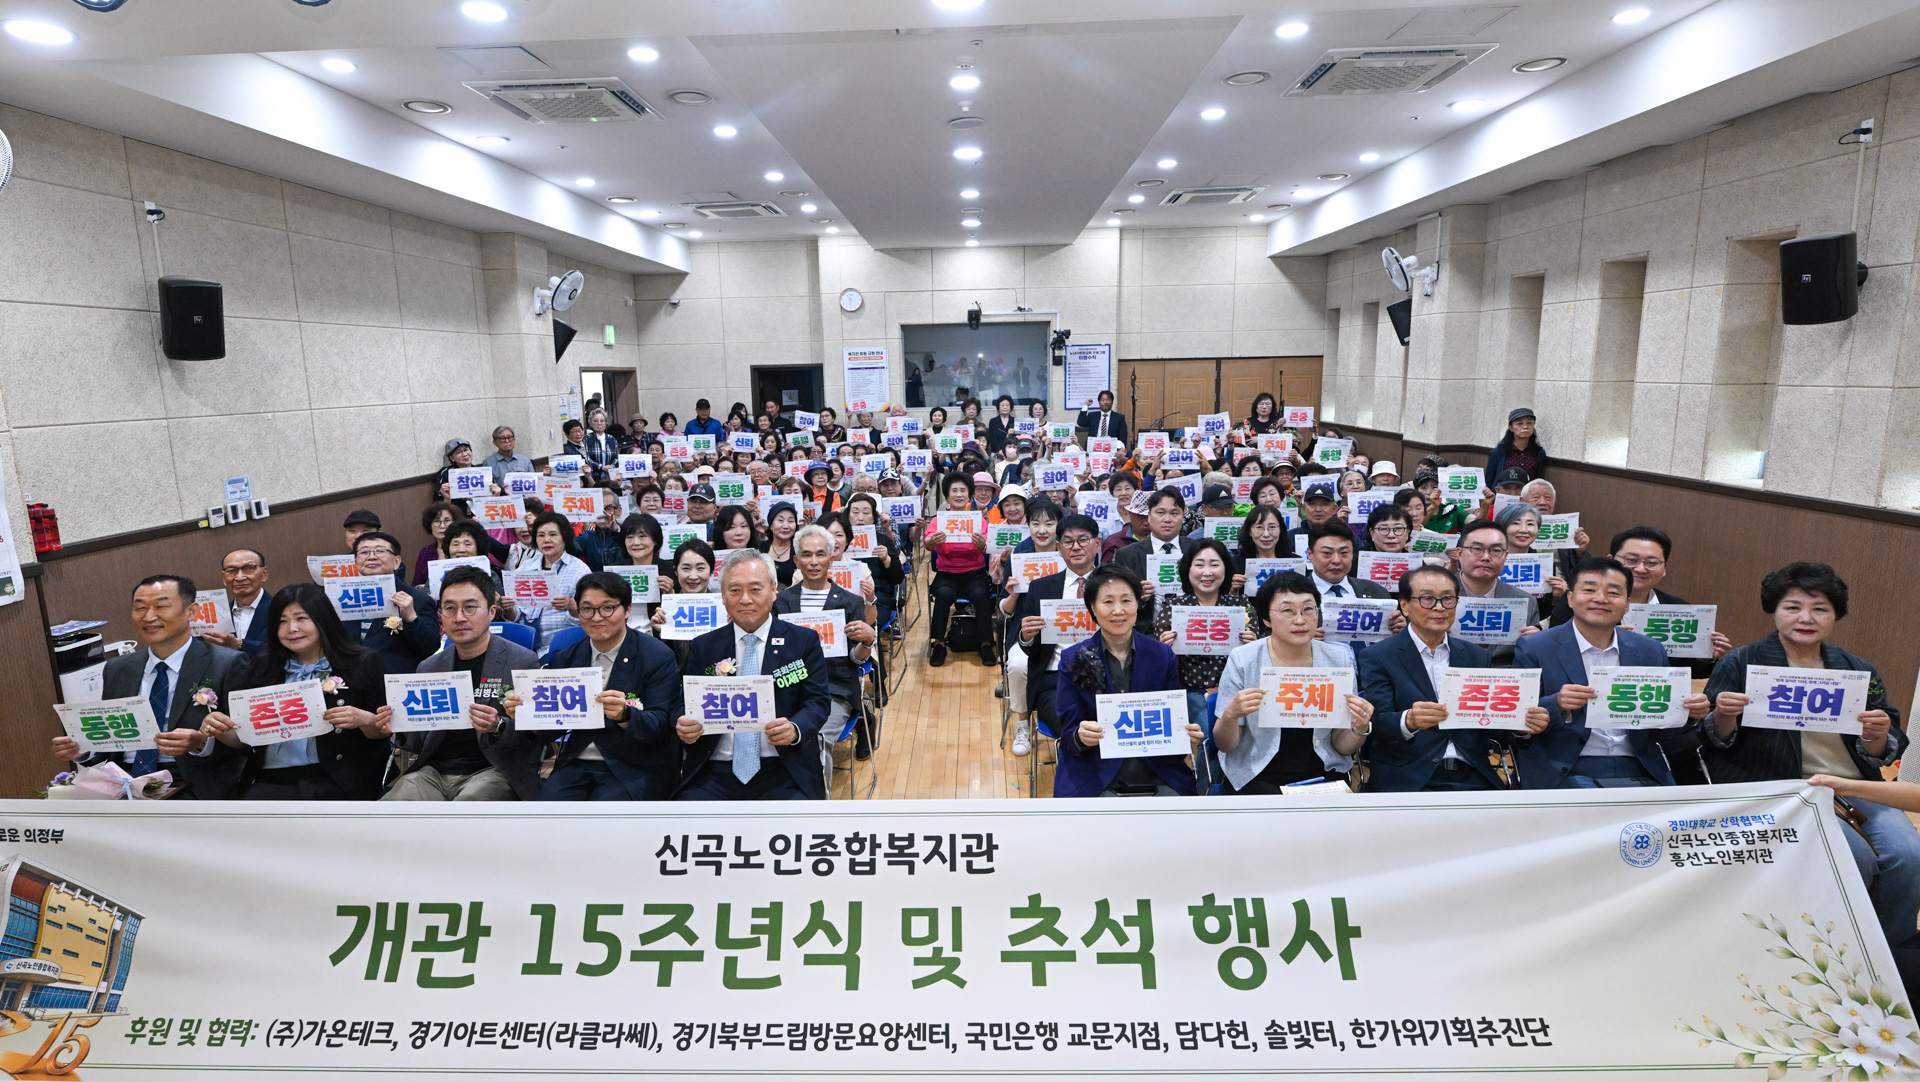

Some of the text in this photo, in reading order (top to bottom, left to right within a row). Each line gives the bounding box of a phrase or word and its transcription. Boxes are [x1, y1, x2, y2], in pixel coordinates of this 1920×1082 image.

[853, 401, 866, 410] 존중
[800, 416, 814, 426] 참여
[1290, 412, 1307, 421] 존중
[902, 422, 918, 431] 신뢰
[1053, 428, 1069, 437] 동행
[1205, 419, 1224, 431] 참여
[694, 440, 710, 448] 동행
[736, 438, 753, 447] 신뢰
[792, 436, 808, 445] 동행
[851, 434, 866, 442] 주체
[887, 437, 903, 446] 참여
[940, 439, 957, 448] 동행
[1145, 439, 1164, 449] 존중
[1264, 440, 1286, 450] 주체
[670, 447, 687, 456] 존중
[1093, 443, 1111, 452] 존중
[907, 456, 926, 466] 참여
[1169, 451, 1193, 462] 참여
[1320, 450, 1341, 461] 동행
[555, 461, 578, 471] 신뢰
[625, 460, 646, 471] 참여
[865, 461, 885, 472] 신뢰
[1093, 458, 1109, 470] 존중
[458, 475, 484, 489] 참여
[1044, 470, 1067, 484] 참여
[1448, 476, 1477, 489] 동행
[512, 480, 536, 491] 참여
[544, 485, 572, 498] 주
[718, 484, 744, 497] 동행
[1176, 484, 1196, 499] 여
[563, 497, 594, 513] 주체
[664, 498, 685, 510] 존중
[891, 504, 914, 516] 참여
[1085, 504, 1108, 519] 참여
[485, 504, 517, 520] 주체
[946, 520, 973, 534] 주체
[1537, 524, 1569, 540] 동행
[995, 533, 1023, 547] 동행
[1413, 540, 1447, 552] 동행
[1023, 563, 1059, 581] 주체
[1370, 563, 1408, 580] 존중
[1500, 564, 1540, 582] 신뢰
[515, 581, 548, 597] 존중
[338, 587, 384, 608] 신뢰
[193, 602, 218, 624] 체
[672, 606, 716, 627] 신뢰
[1459, 608, 1511, 632] 신뢰
[1054, 612, 1098, 632] 주체
[1337, 610, 1382, 632] 참여
[1186, 619, 1230, 641] 존중
[1644, 618, 1698, 643] 동행
[773, 658, 805, 678] 국회의원
[777, 667, 809, 688] 이재강
[403, 688, 459, 715] 신뢰
[532, 685, 587, 712] 참여
[1276, 683, 1334, 712] 주체
[1459, 685, 1520, 712] 존중
[1608, 684, 1671, 713] 동행
[1768, 685, 1844, 716] 참여
[250, 698, 308, 729] 존중
[702, 693, 758, 719] 참여
[81, 713, 139, 740] 동행
[1114, 708, 1172, 739] 신뢰
[1668, 814, 1776, 831] 경민대학교 산학협력단
[24, 829, 64, 844] 의정부
[1667, 828, 1799, 849] 신곡노인종합복지관
[655, 832, 998, 876] 신곡노인종합복지관
[1670, 849, 1774, 867] 흥선노인복지관
[329, 893, 1362, 990] 개관 15주년식 및 추석 행사
[16, 961, 59, 975] 신곡노인종합복지관
[125, 1017, 1553, 1053] 후원 및 협력: (주)가온테크, 경기아트센터(라클라쎄), 경기북부드림방문요양센터, 국민은행 교문지점, 담다헌, 솔빛터, 한가위기획추진단
[11, 1011, 103, 1076] 15
